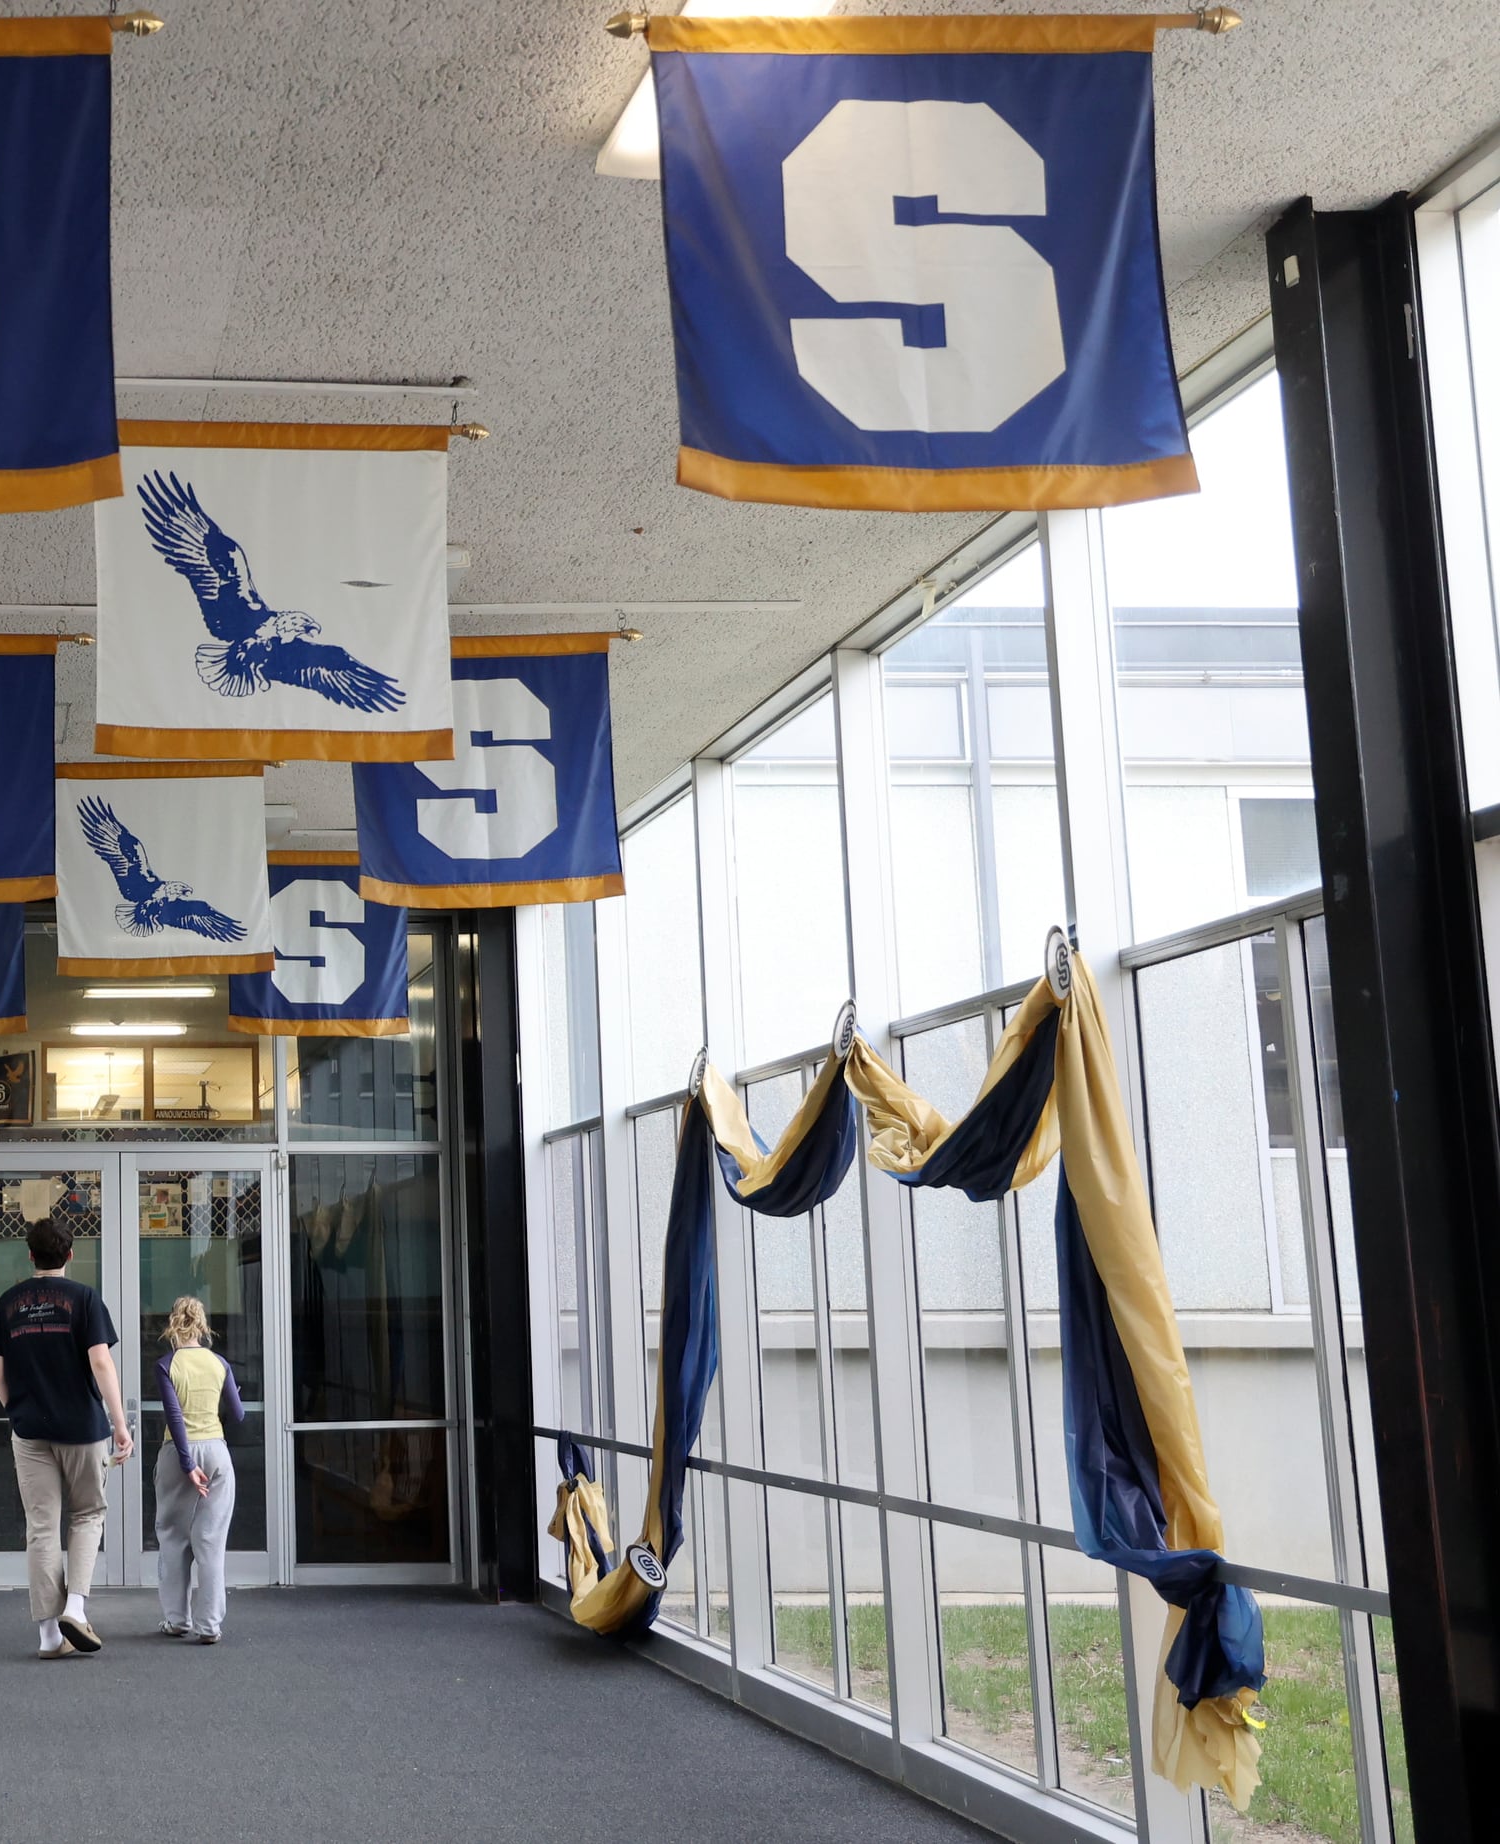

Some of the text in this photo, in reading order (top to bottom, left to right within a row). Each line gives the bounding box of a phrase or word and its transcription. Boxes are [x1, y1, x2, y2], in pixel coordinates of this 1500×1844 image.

[782, 99, 1067, 434] S
[414, 677, 559, 860] S
[268, 878, 367, 1005] S
[155, 1110, 208, 1120] ANNOUNCEMENTS
[638, 1555, 663, 1581] S
